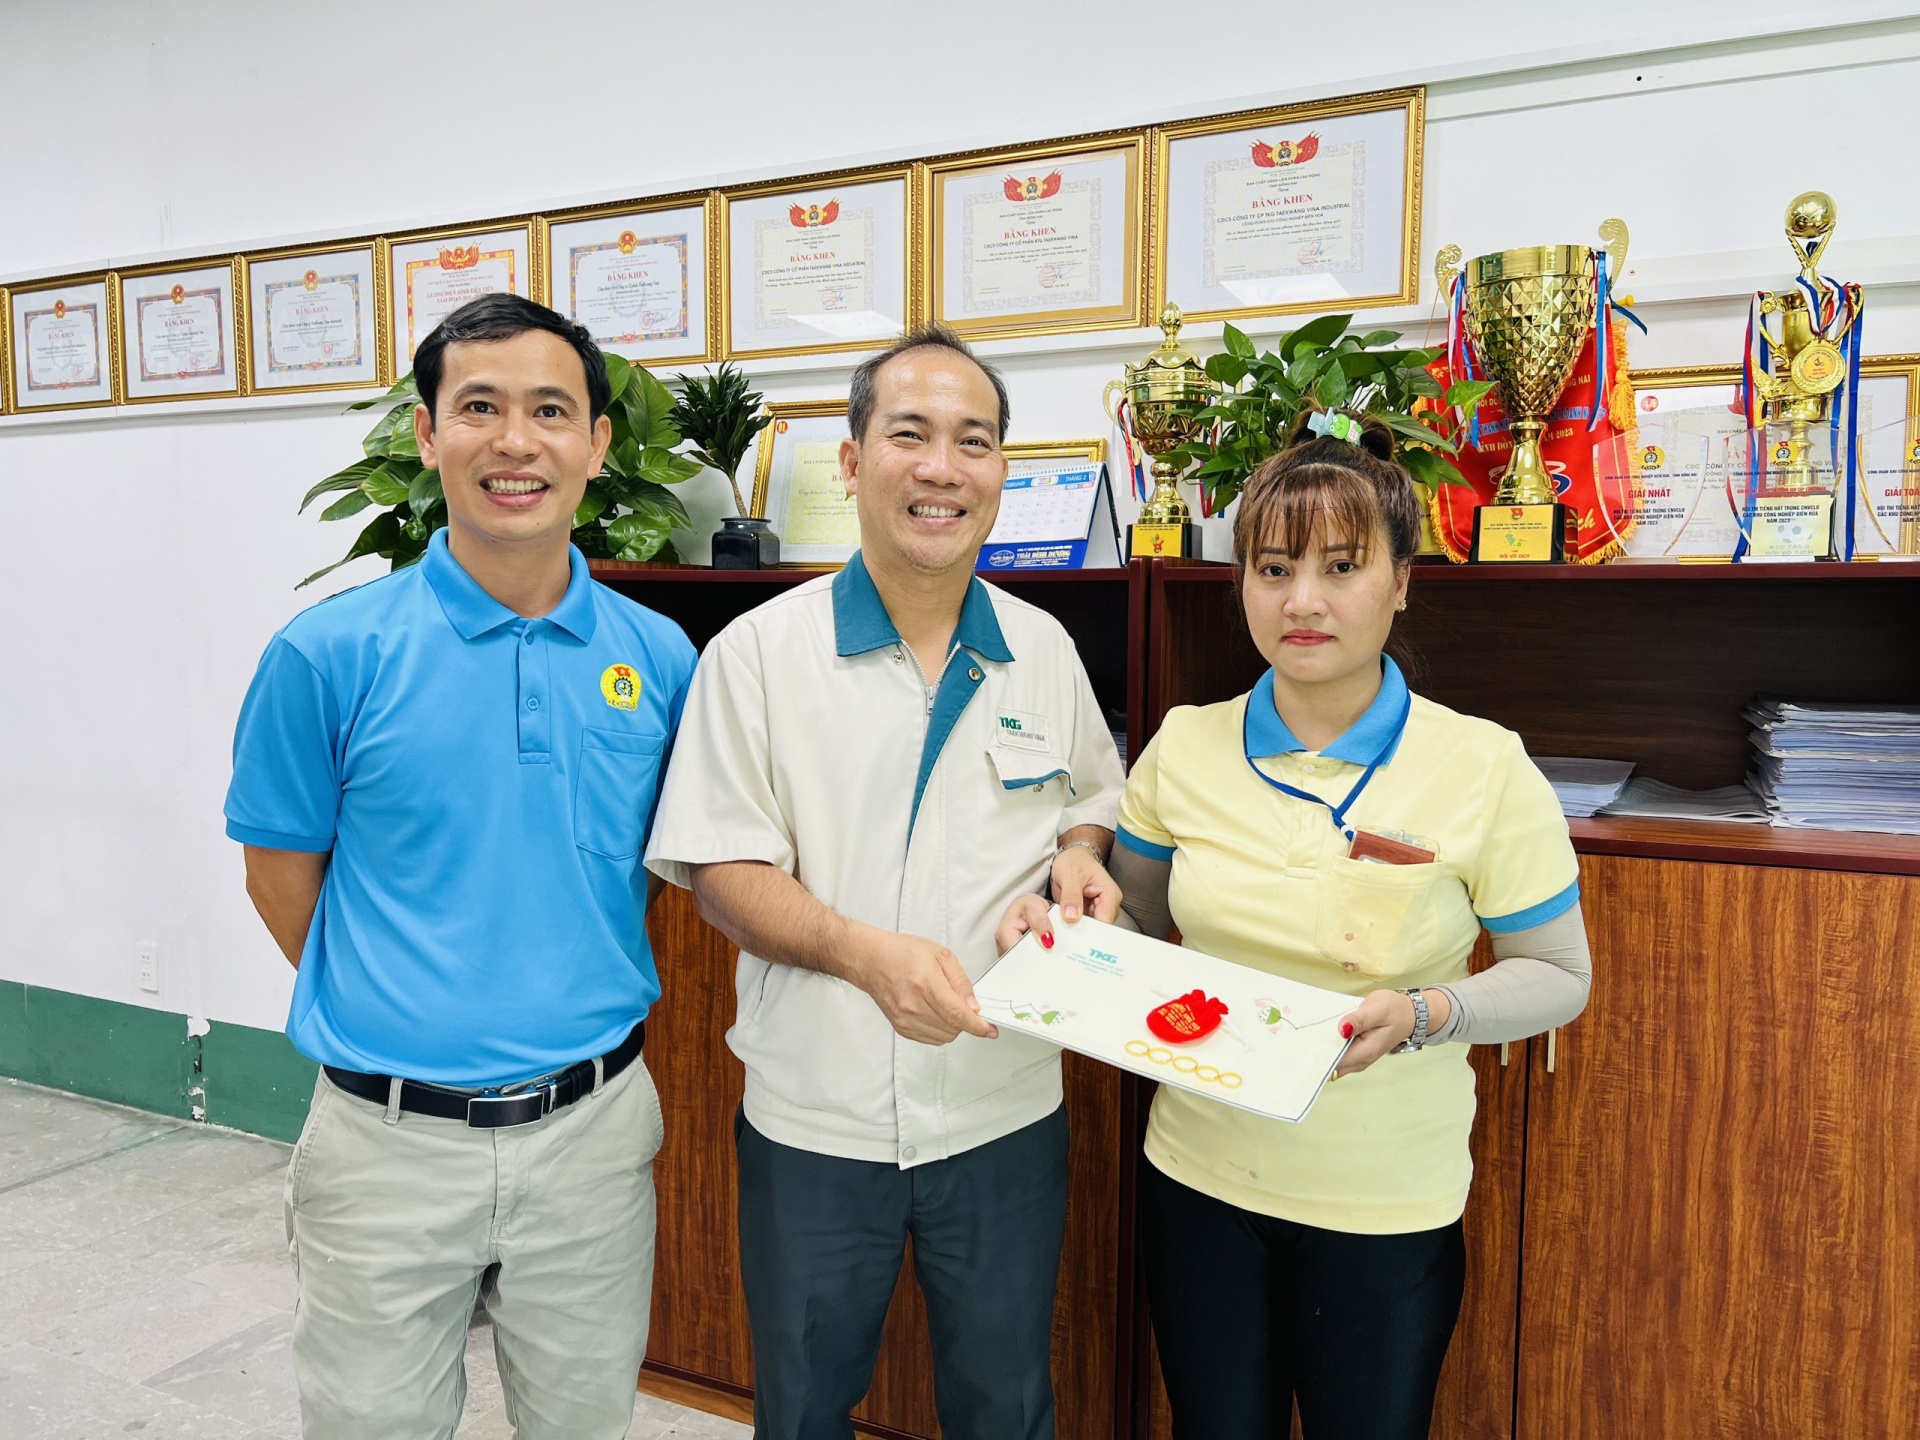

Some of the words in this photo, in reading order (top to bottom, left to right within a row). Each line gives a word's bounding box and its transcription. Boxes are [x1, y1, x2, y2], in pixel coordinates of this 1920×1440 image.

[1252, 196, 1280, 208] BẰNG
[1283, 193, 1314, 205] KHEN
[1232, 214, 1249, 222] CÔNG
[1276, 208, 1306, 216] TAEKWANG
[1320, 202, 1351, 210] INDUSTRIAL
[1004, 228, 1030, 240] BẰNG
[1031, 226, 1057, 237] KHEN
[790, 251, 812, 262] BẰNG
[814, 251, 836, 260] KHEN
[608, 270, 627, 282] BẰNG
[628, 270, 649, 280] KHEN
[312, 305, 330, 314] KHEN
[1578, 374, 1591, 384] NAI
[1556, 427, 1574, 439] 2023
[1628, 486, 1646, 498] GIẢI
[1648, 485, 1671, 498] NHẤT
[1884, 486, 1902, 497] GIẢI
[999, 716, 1022, 730] TKG
[1089, 948, 1118, 964] TKG
